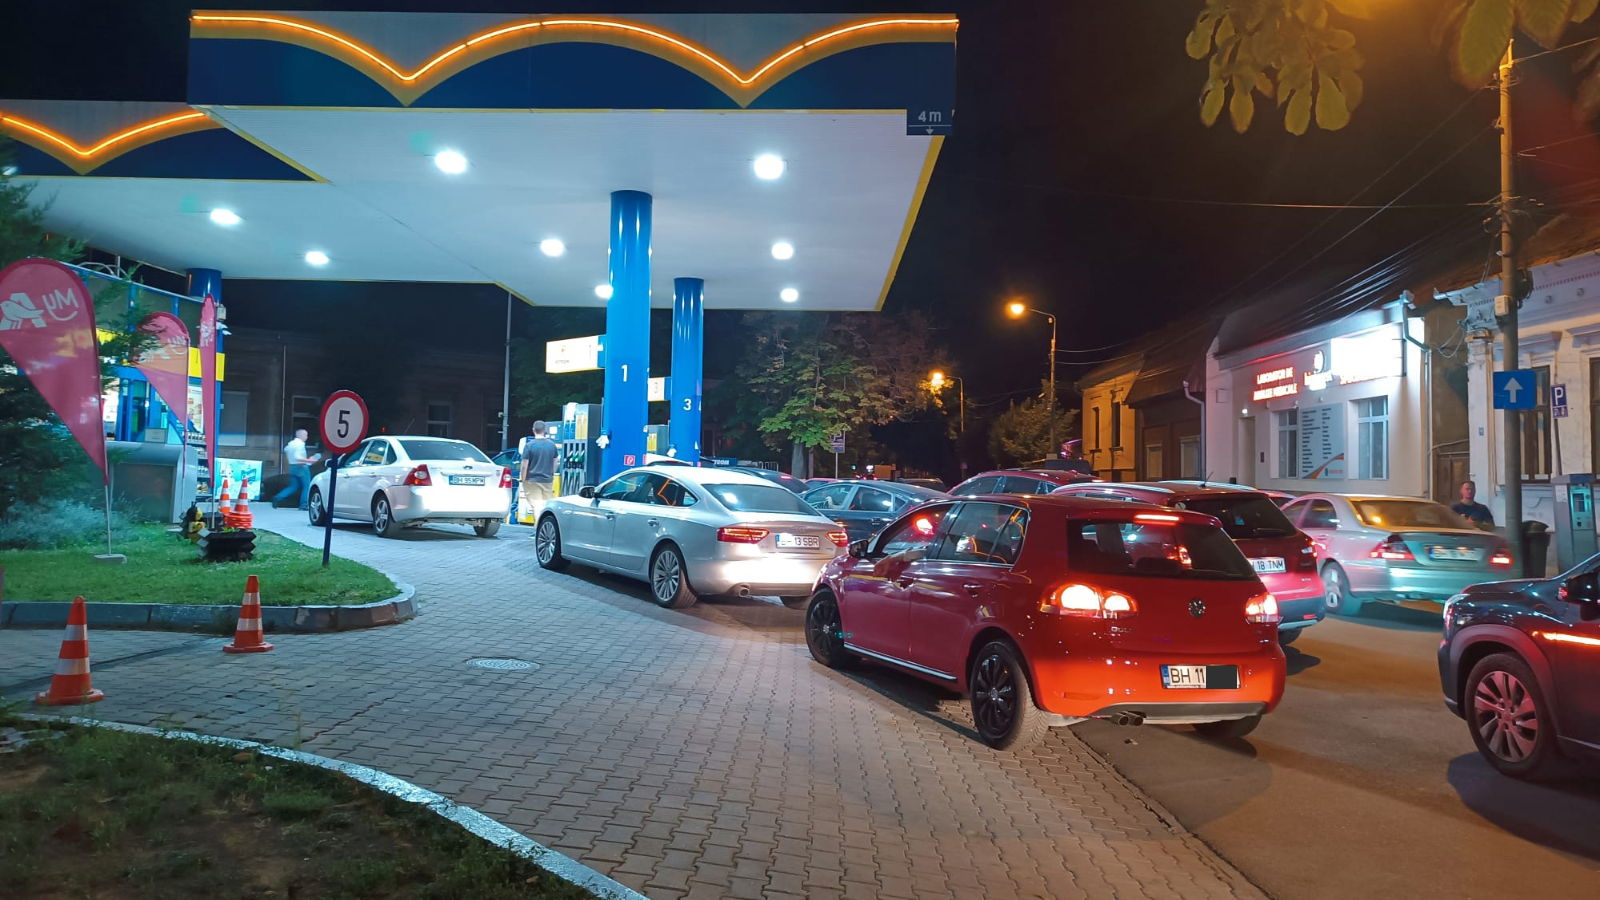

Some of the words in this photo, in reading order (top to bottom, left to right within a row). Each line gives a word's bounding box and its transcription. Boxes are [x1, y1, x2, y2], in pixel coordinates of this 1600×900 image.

[621, 364, 628, 382] 1
[683, 398, 692, 411] 3
[1554, 387, 1564, 405] P
[337, 410, 350, 438] 5
[1170, 668, 1190, 683] BH
[1195, 668, 1205, 684] 11
